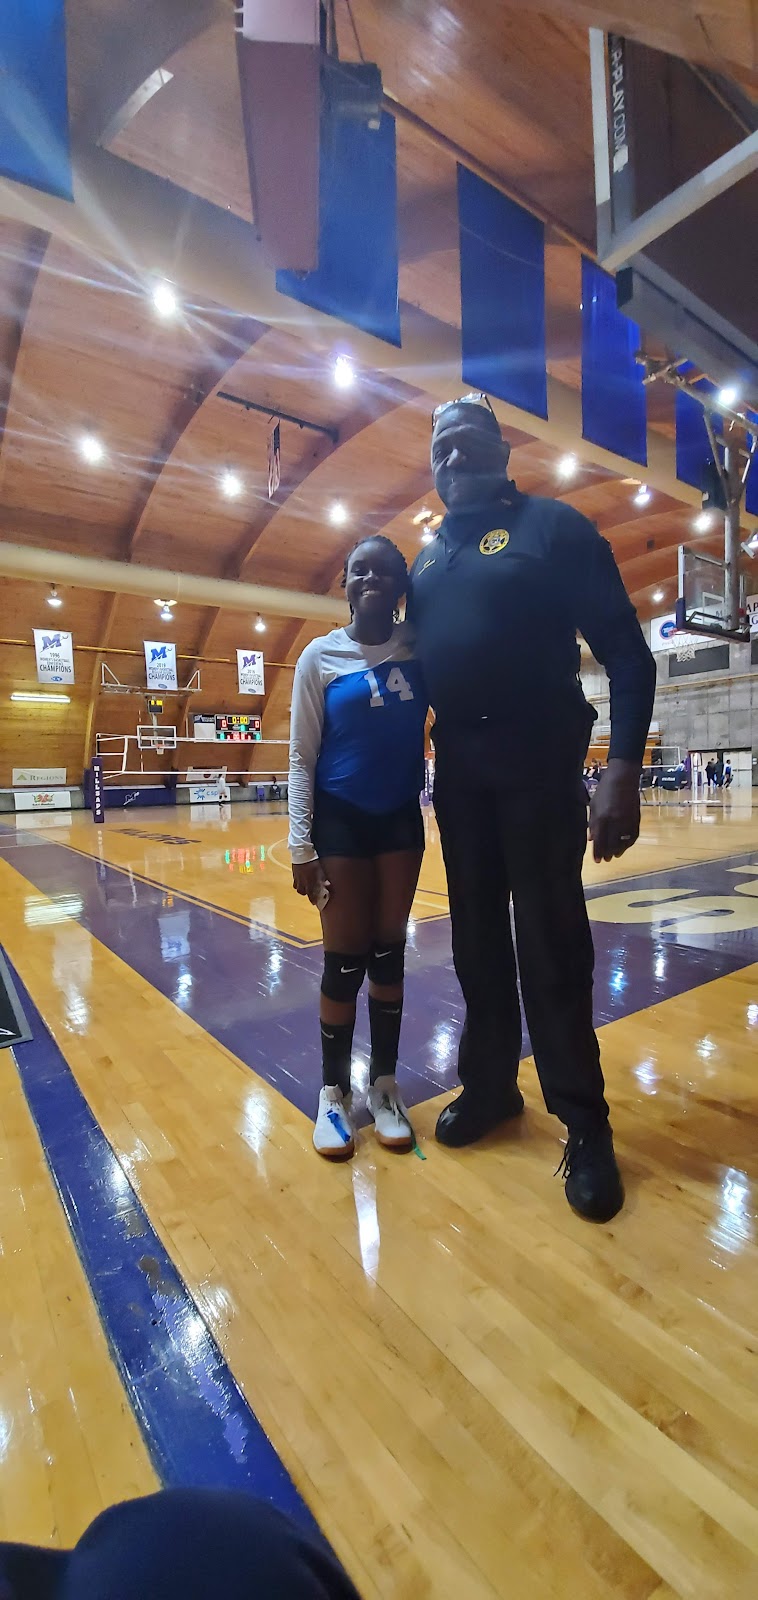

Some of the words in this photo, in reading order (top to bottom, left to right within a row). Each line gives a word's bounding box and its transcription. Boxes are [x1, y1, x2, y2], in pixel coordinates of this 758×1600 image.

[39, 664, 72, 673] CHAMPIONS
[148, 672, 176, 681] CHAMPIONS
[363, 667, 414, 707] 14
[93, 765, 102, 816] MILLSAPS
